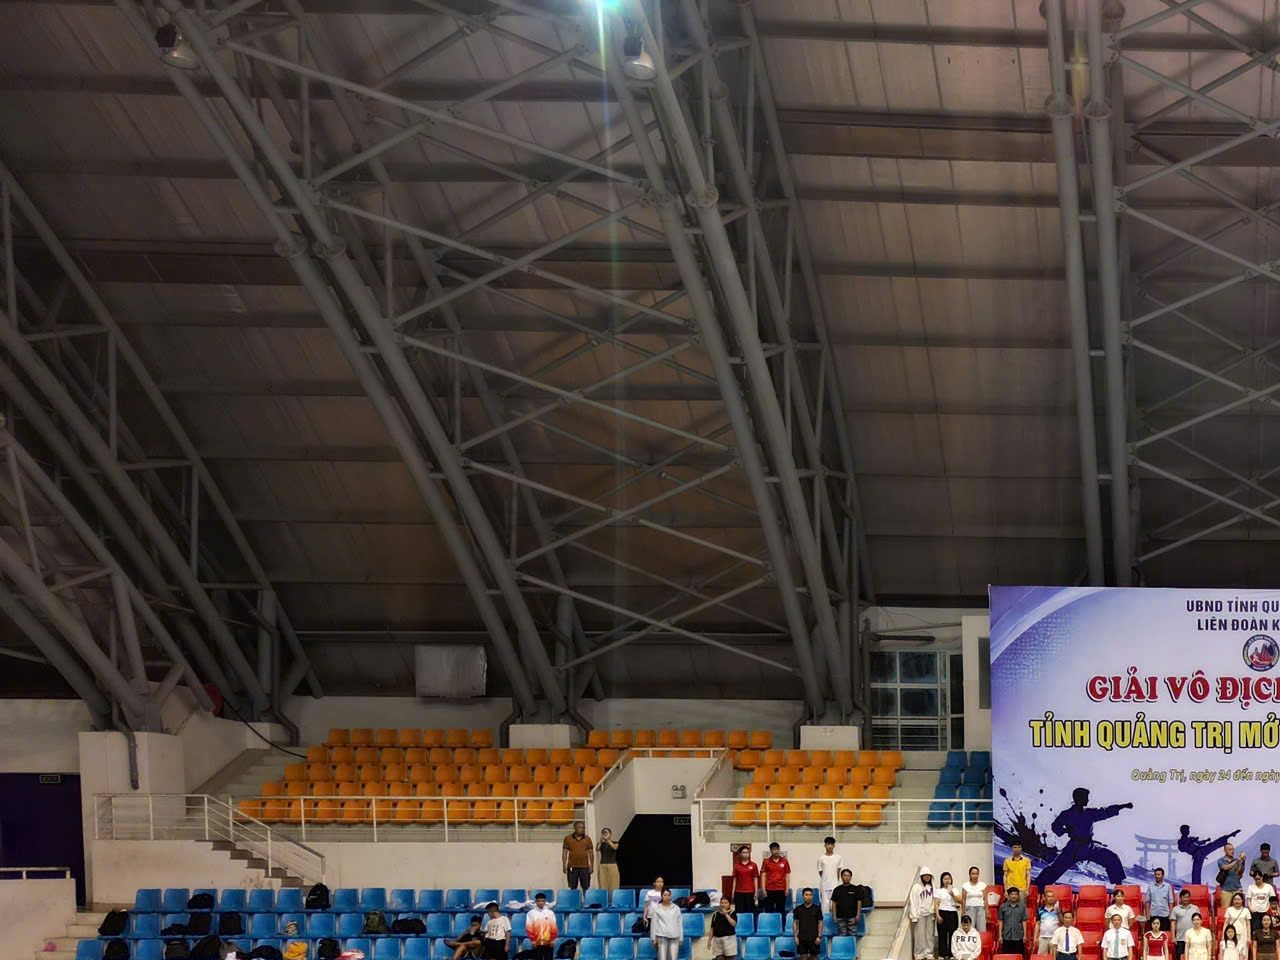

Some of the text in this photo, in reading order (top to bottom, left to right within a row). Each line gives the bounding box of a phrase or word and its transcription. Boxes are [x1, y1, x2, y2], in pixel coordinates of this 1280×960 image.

[1186, 600, 1223, 613] UBND
[1228, 597, 1258, 613] TỈNH
[1197, 616, 1227, 631] LIÊN
[1231, 616, 1268, 631] ĐOÀN
[1086, 666, 1159, 702] GIẢI
[1164, 670, 1210, 703] VÔ
[1029, 711, 1091, 748] TỈNH
[1096, 712, 1186, 750] QUẢNG
[1191, 721, 1233, 754] TRỊ
[1238, 712, 1280, 748] MỞ
[1131, 768, 1167, 783] Quảng
[1189, 769, 1216, 783] ngày
[1233, 768, 1253, 781] đến
